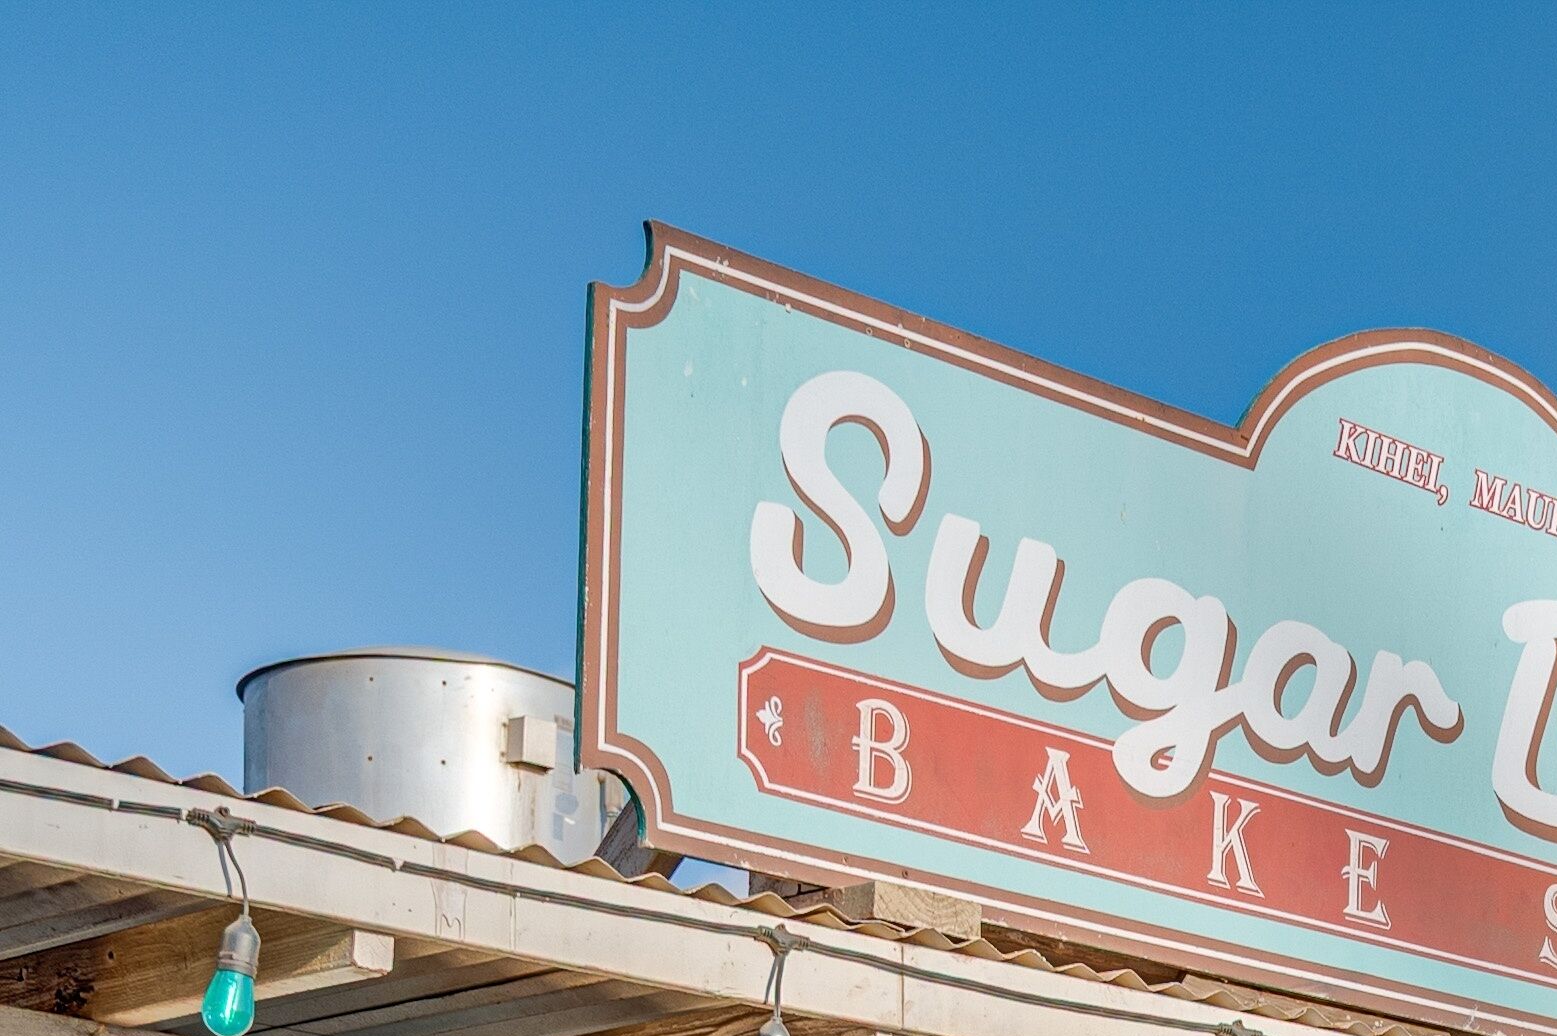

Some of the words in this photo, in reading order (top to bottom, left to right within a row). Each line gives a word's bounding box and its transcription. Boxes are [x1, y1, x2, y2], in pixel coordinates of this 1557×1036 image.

[1333, 418, 1449, 506] KIHEI,
[750, 370, 1463, 805] Sugar
[851, 697, 1392, 931] BAKE
